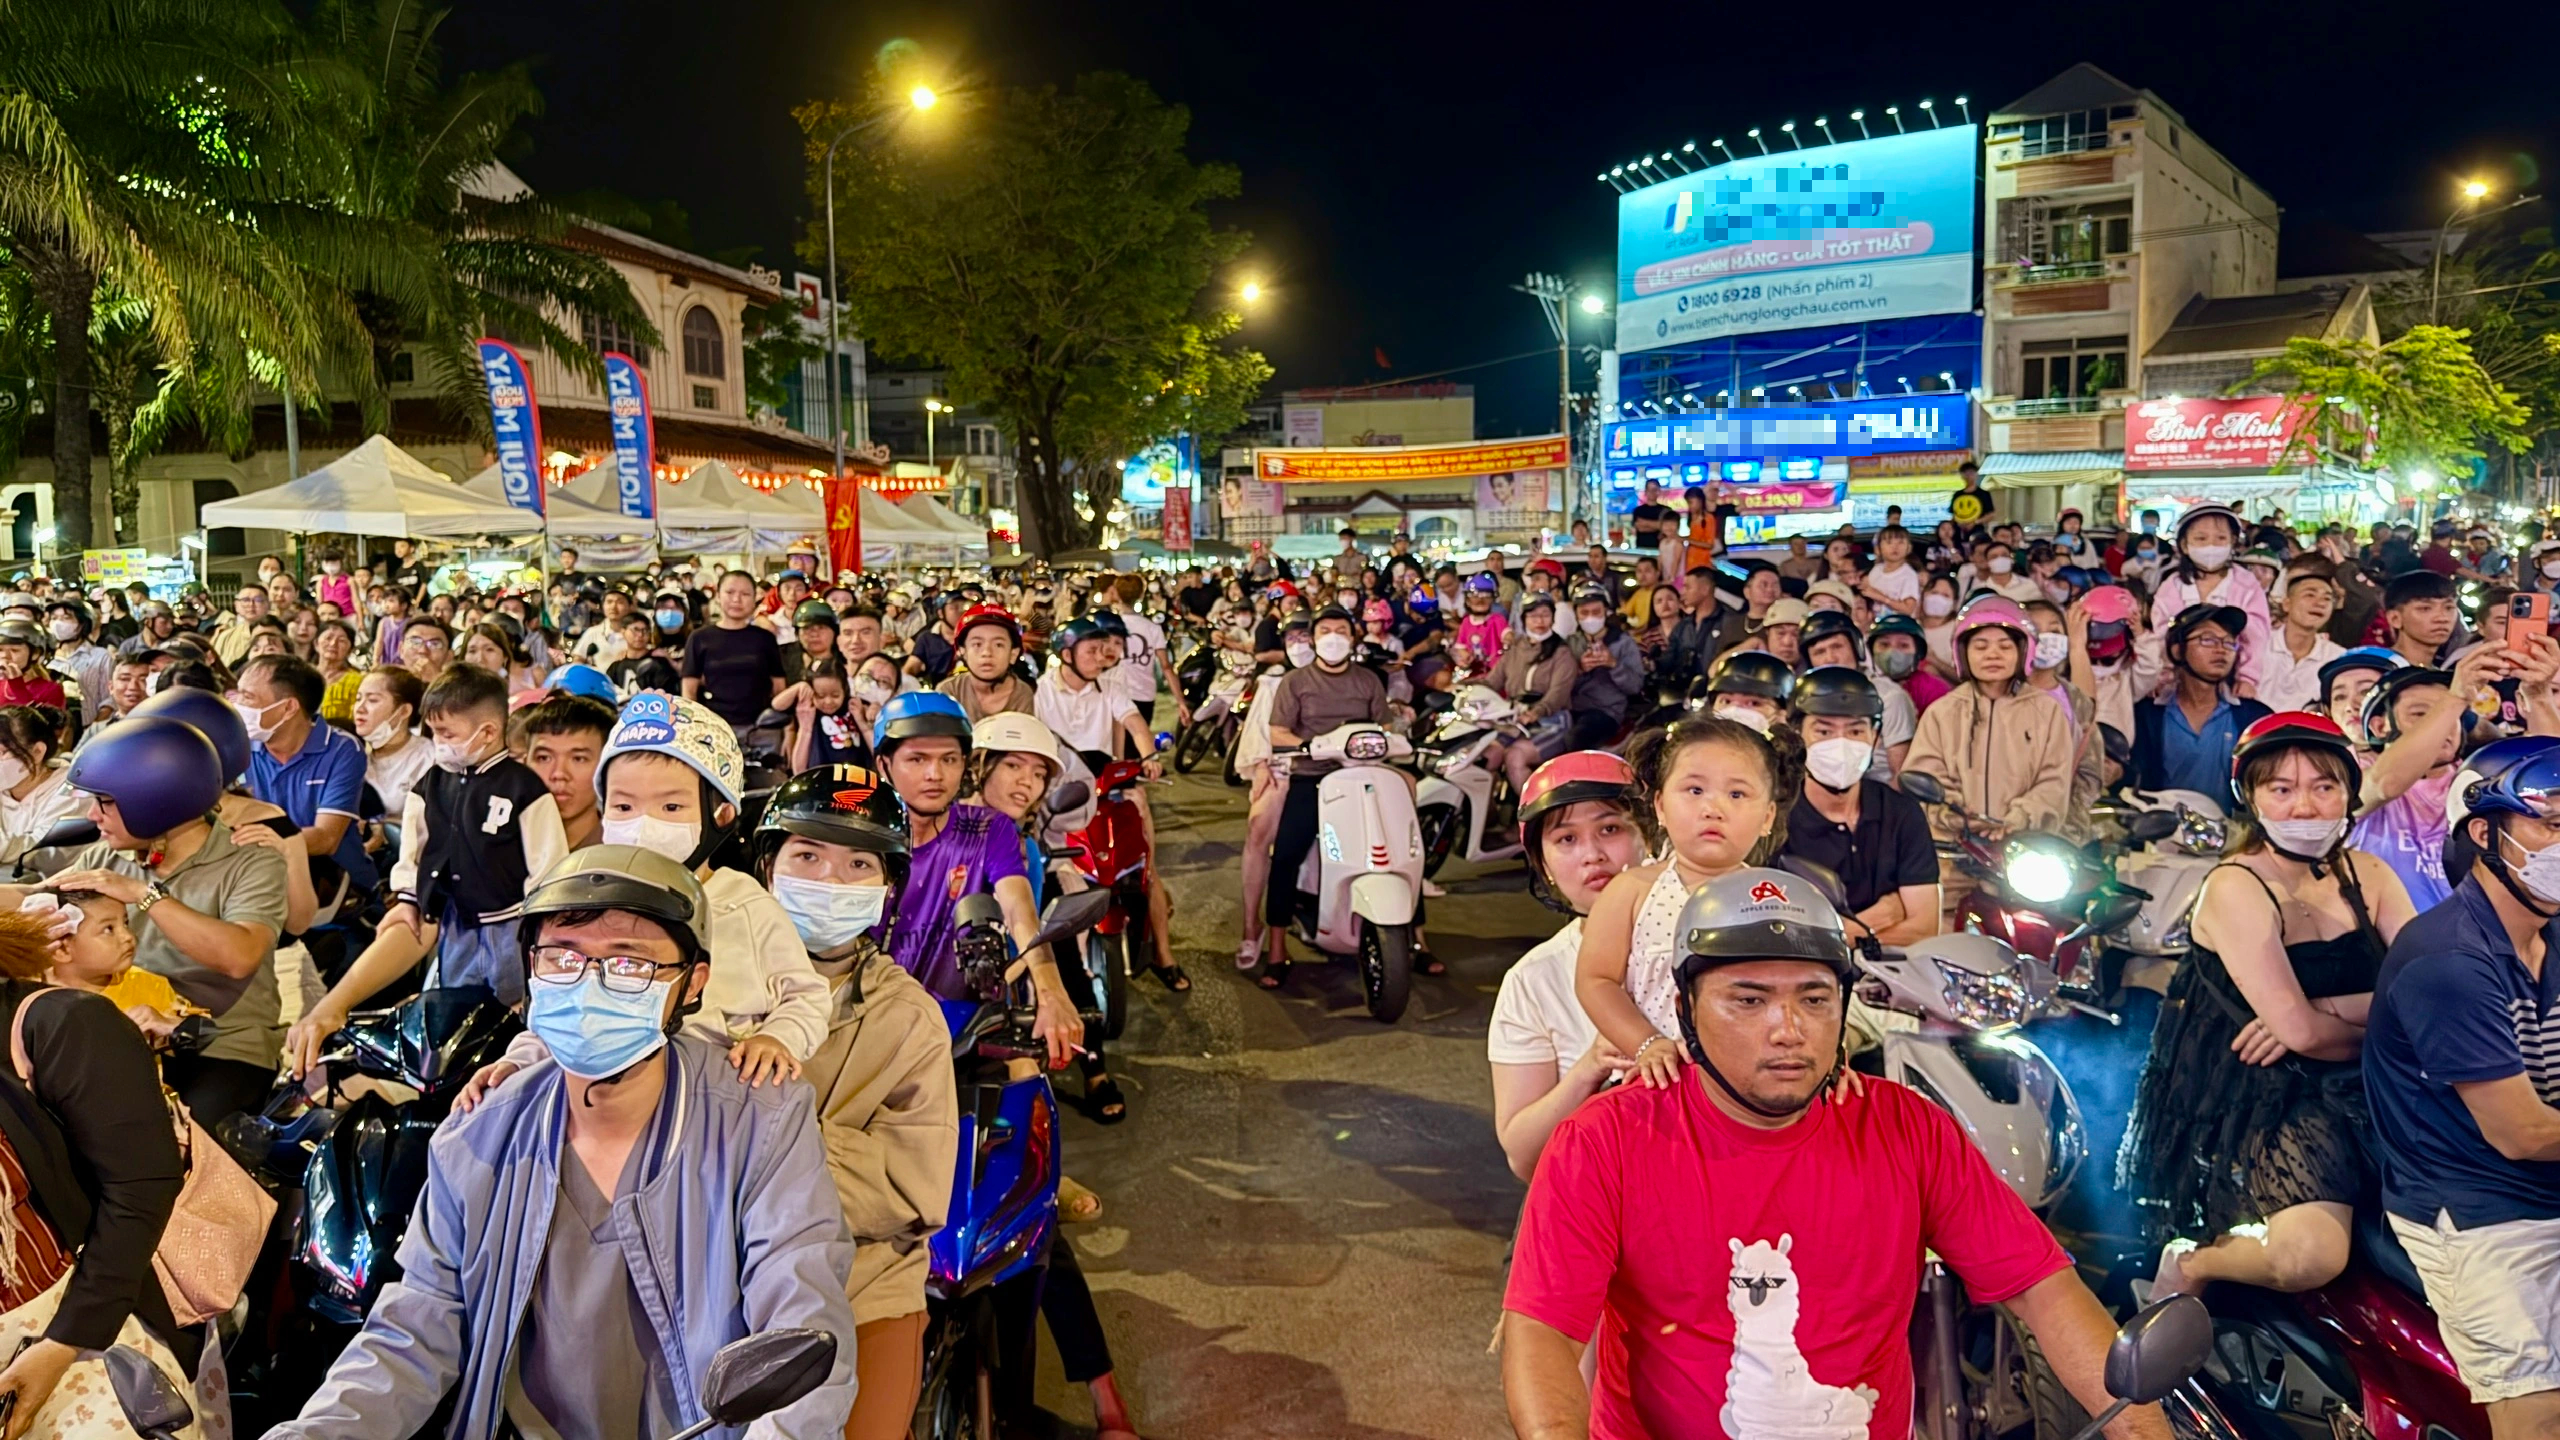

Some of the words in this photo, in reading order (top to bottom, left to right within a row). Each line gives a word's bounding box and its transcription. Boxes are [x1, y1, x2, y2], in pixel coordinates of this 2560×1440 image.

[1865, 232, 1915, 256] THẬT
[1691, 292, 1719, 310] 1800
[1721, 285, 1761, 305] 6928
[1858, 272, 1873, 289] 2)
[1880, 453, 1965, 470] PHOTOCOPY
[619, 726, 669, 744] HAPPY
[481, 794, 514, 836] P
[830, 801, 872, 817] HONDA
[1740, 905, 1763, 913] APPLE
